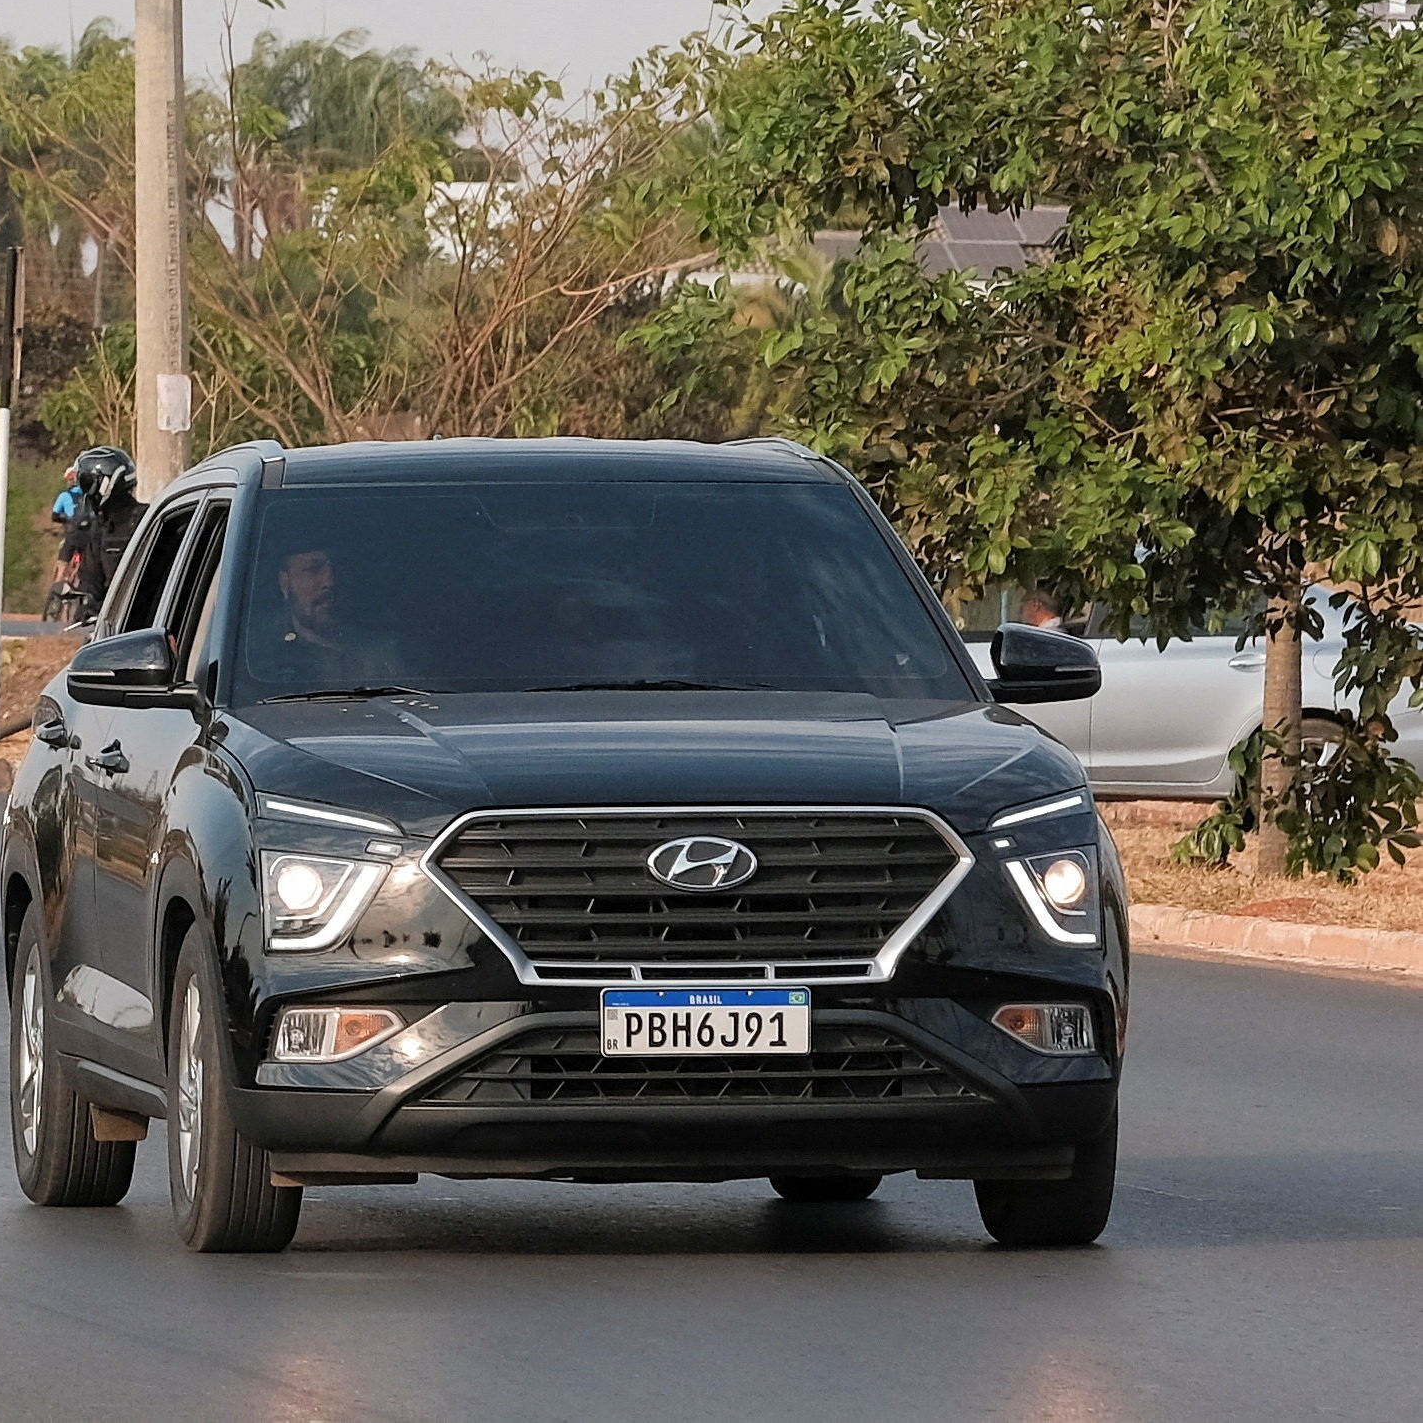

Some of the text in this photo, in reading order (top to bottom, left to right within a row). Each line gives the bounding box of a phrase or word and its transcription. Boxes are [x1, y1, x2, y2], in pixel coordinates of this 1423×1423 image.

[689, 994, 722, 1005] BRASIL
[607, 1012, 787, 1050] BR PBH6J91
